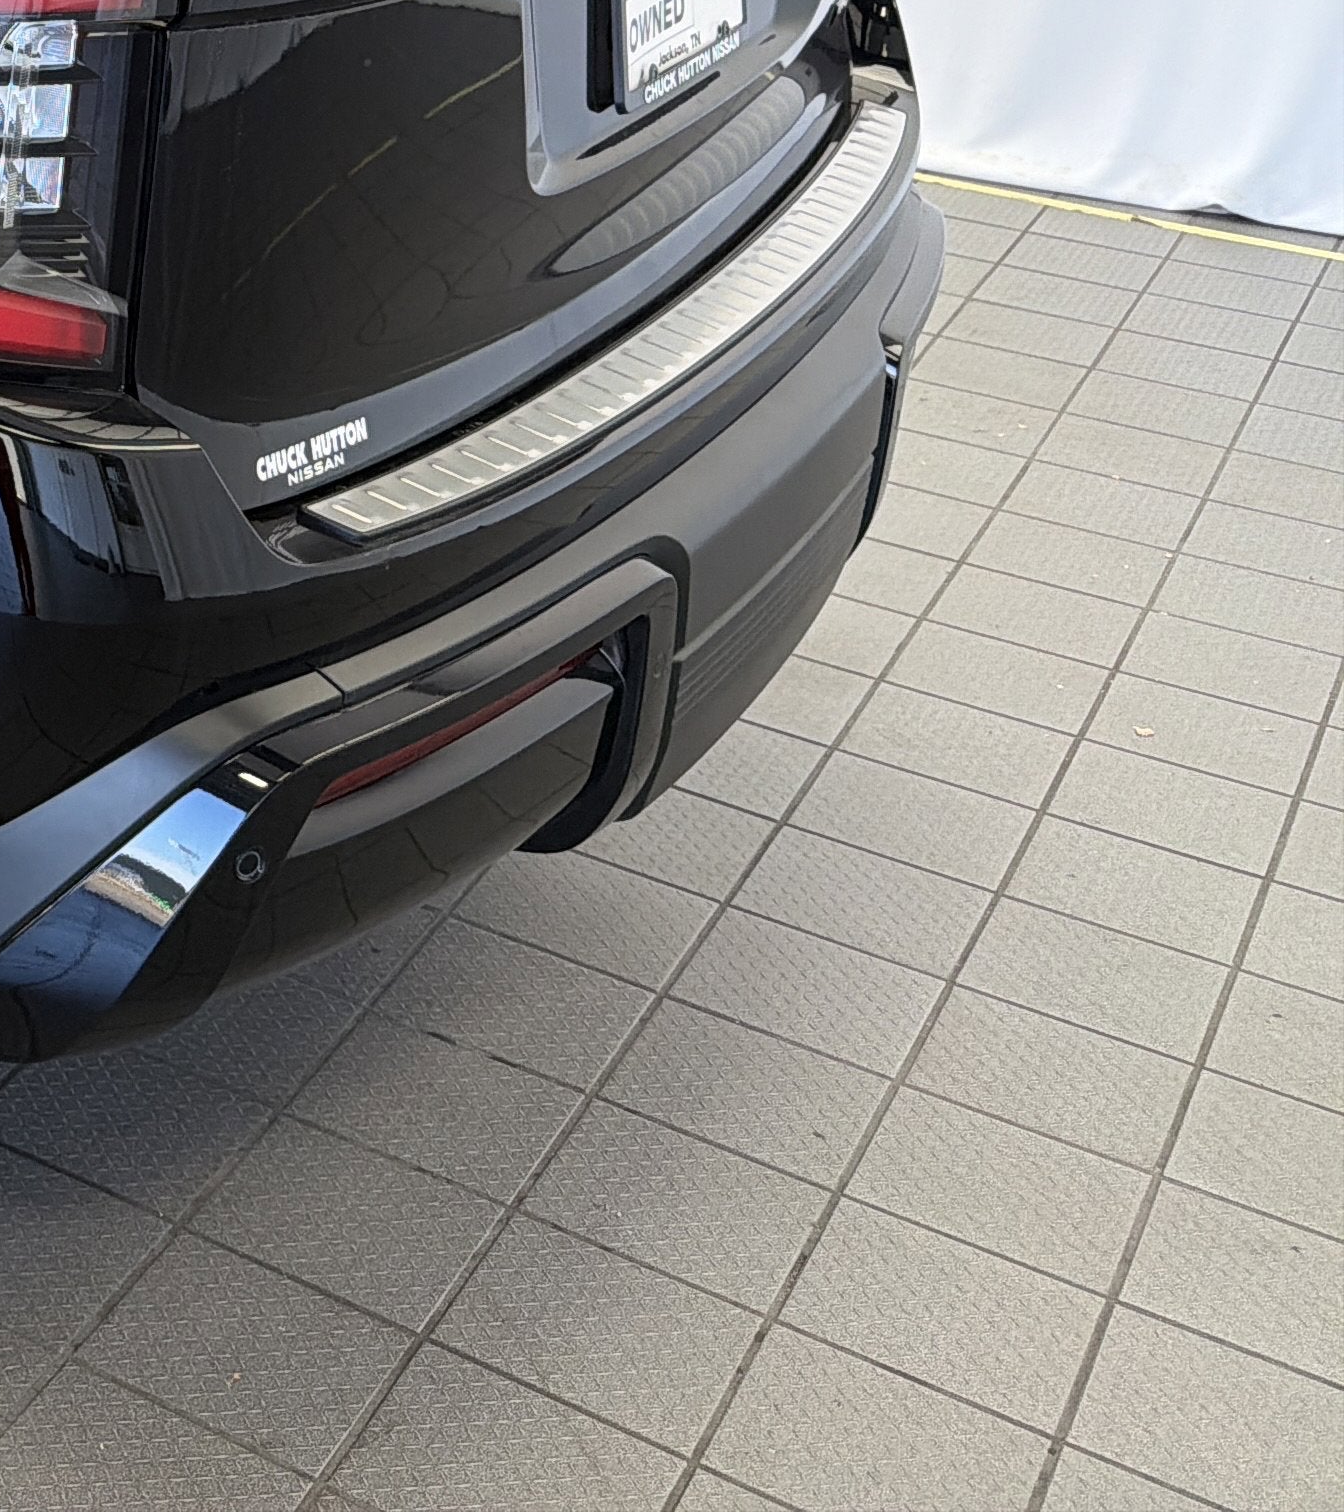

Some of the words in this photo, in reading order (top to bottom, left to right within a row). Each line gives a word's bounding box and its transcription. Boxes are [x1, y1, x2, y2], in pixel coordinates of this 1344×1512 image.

[644, 70, 678, 104] CHUCK
[678, 47, 712, 86] HUTTON
[712, 30, 740, 64] NISSAN
[255, 440, 309, 482] CHUCK
[310, 416, 369, 462] HUTTON
[287, 451, 346, 487] NISSAN
